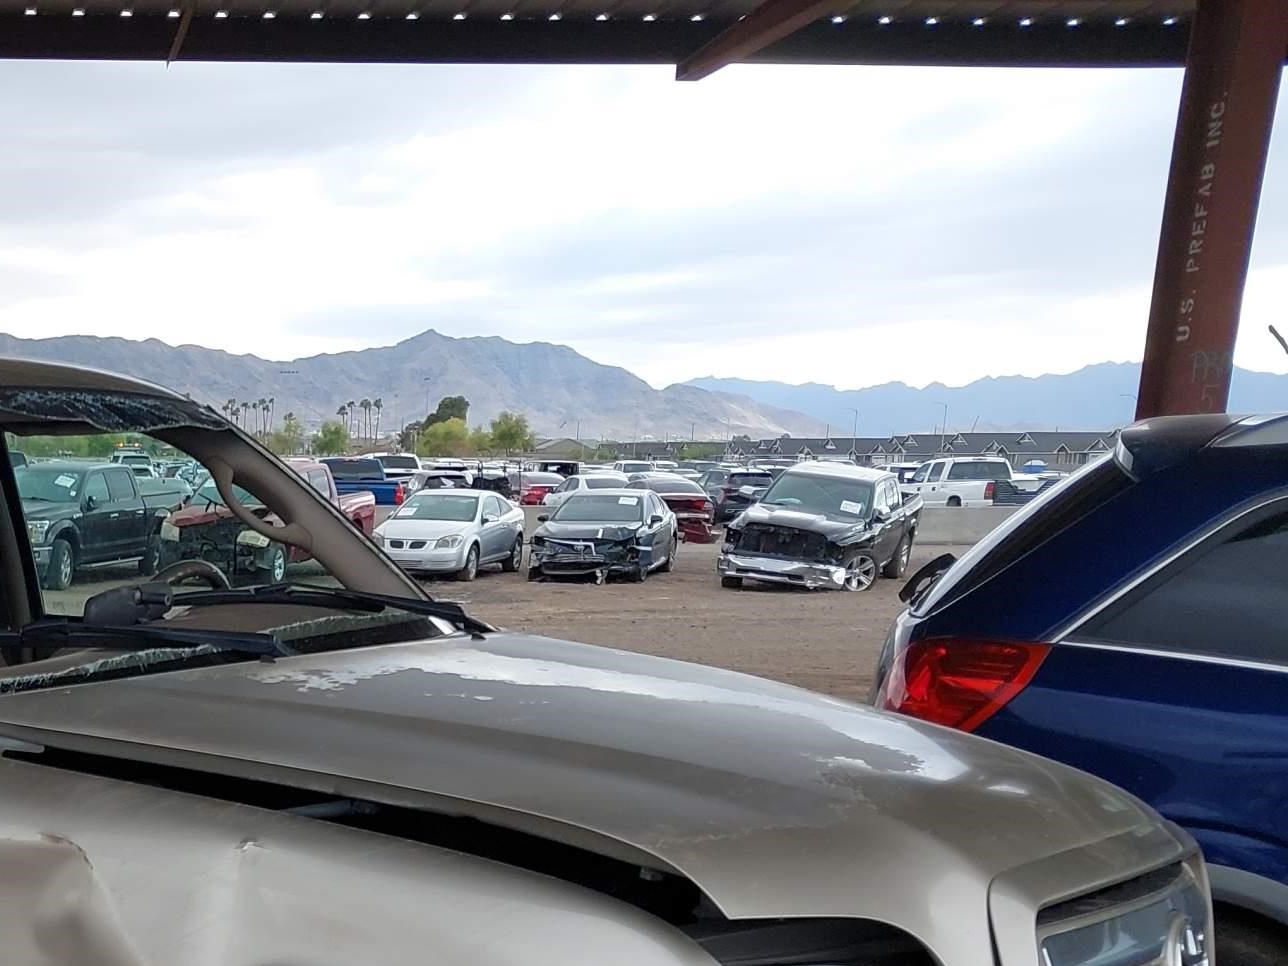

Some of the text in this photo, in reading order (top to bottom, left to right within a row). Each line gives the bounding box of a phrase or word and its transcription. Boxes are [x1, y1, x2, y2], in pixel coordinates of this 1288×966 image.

[1175, 91, 1229, 342] U.S. PREFAB INC.
